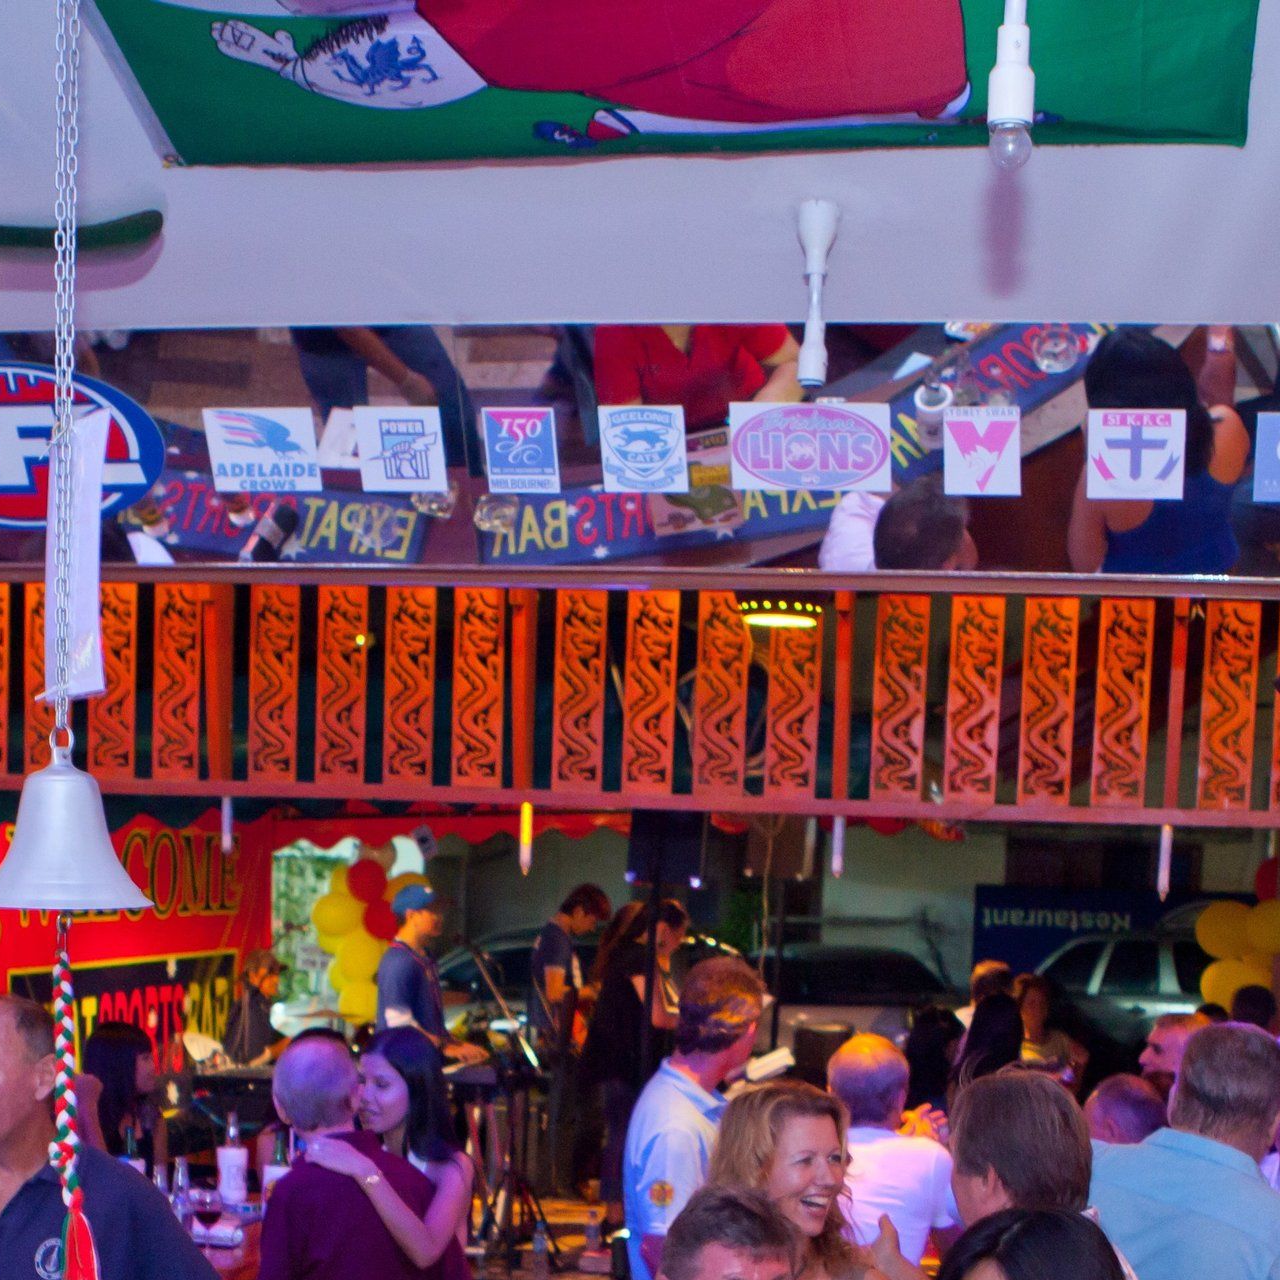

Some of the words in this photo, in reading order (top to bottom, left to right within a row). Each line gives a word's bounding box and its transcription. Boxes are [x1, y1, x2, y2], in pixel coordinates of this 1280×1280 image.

[611, 408, 670, 424] GEELONG
[381, 421, 424, 434] POWER
[747, 432, 876, 471] LIONS
[215, 463, 317, 478] ADELAIDE
[239, 479, 297, 490] CROWS
[981, 906, 1131, 932] Restaurant
